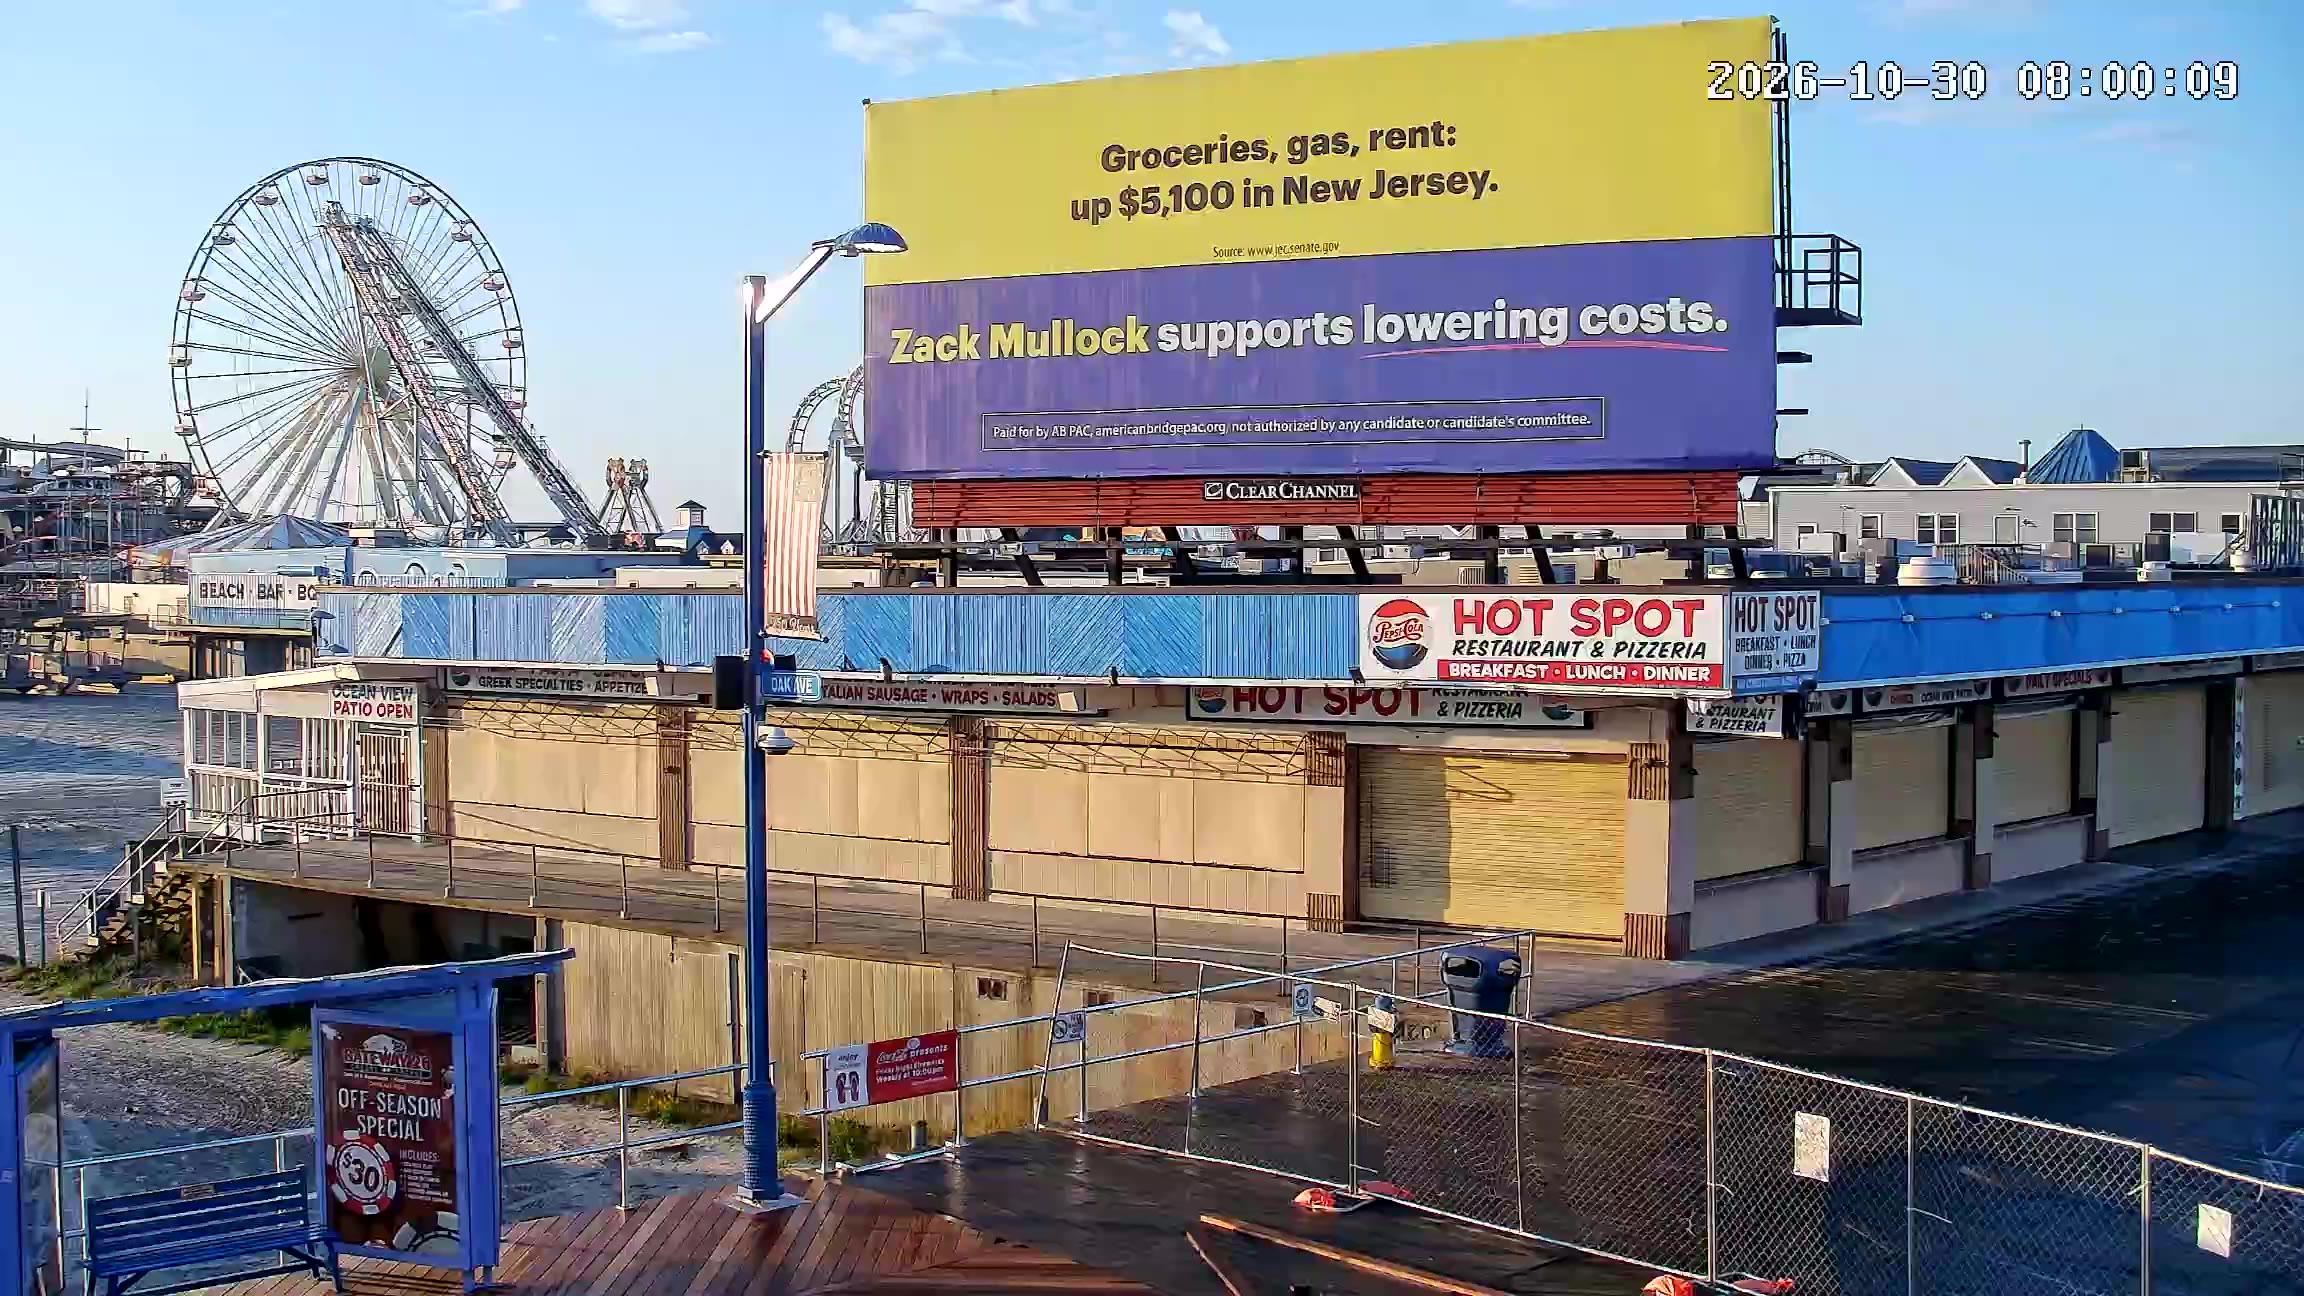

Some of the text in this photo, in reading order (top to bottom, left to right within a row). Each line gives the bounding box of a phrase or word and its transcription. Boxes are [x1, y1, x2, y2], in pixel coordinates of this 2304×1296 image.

[1101, 120, 1457, 172] Groceries, gas, rent:
[1071, 169, 1499, 225] up $5,100 in New Jersey.
[1213, 244, 1245, 258] Source:
[888, 297, 1728, 364] Zack Mullock supports lowering costs.
[993, 426, 1017, 438] Paid
[1018, 426, 1034, 438] for
[1036, 426, 1049, 440] by
[1051, 425, 1067, 437] AB
[1069, 424, 1093, 438] PAC,
[1231, 421, 1251, 433] not
[1253, 419, 1317, 433] authorized
[1320, 418, 1337, 435] by
[1338, 419, 1360, 433] any
[1362, 416, 1424, 430] candidate
[1426, 418, 1441, 429] or
[1442, 415, 1514, 430] candidate's
[1517, 412, 1591, 427] committee.
[199, 582, 245, 600] BEACH
[1452, 598, 1706, 638] HOT SPOT
[1735, 595, 1817, 633] HOT SPOT
[1451, 639, 1707, 660] RESTAURANT & PIZZERIA
[1735, 634, 1817, 653] BREAKFAST LUNCH
[1783, 652, 1806, 669] PIZZA
[1449, 661, 1712, 683] BREAKFAST LUNCH DINNER
[331, 683, 414, 700] OCEAN VIEW
[478, 675, 512, 689] GREEK
[515, 677, 584, 692] SPECIALTIES
[771, 676, 813, 694] OAK AVE
[867, 686, 928, 704] SAUSAGE
[940, 688, 989, 705] WRAPS
[1001, 690, 1057, 707] SALADS
[1232, 688, 1424, 718] HOT SPOT
[333, 700, 413, 719] PATIO OPEN
[1436, 701, 1523, 720] & PIZZERIA
[1695, 717, 1767, 732] & PIZZERIA
[338, 1087, 442, 1120] OFF-SEASON
[357, 1114, 425, 1142] SPECIAL
[341, 1151, 380, 1193] $30
